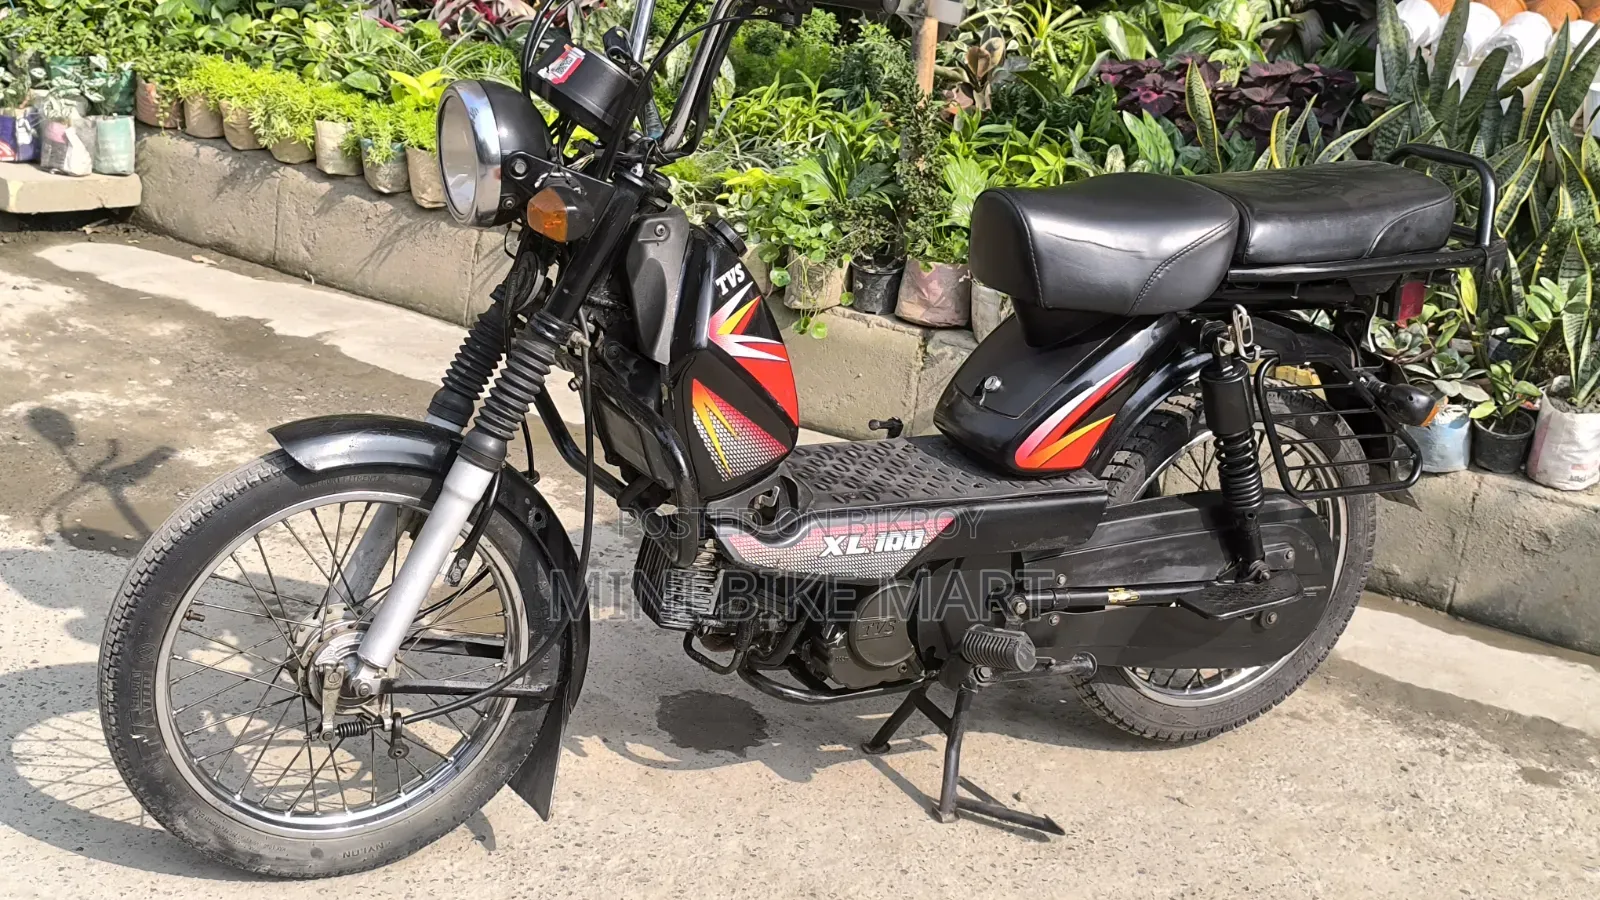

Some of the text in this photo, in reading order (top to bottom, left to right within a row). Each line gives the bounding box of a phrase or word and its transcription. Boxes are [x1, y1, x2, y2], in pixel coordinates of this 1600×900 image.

[715, 262, 746, 296] TVS
[818, 529, 926, 558] XL 100
[860, 619, 897, 638] TVS
